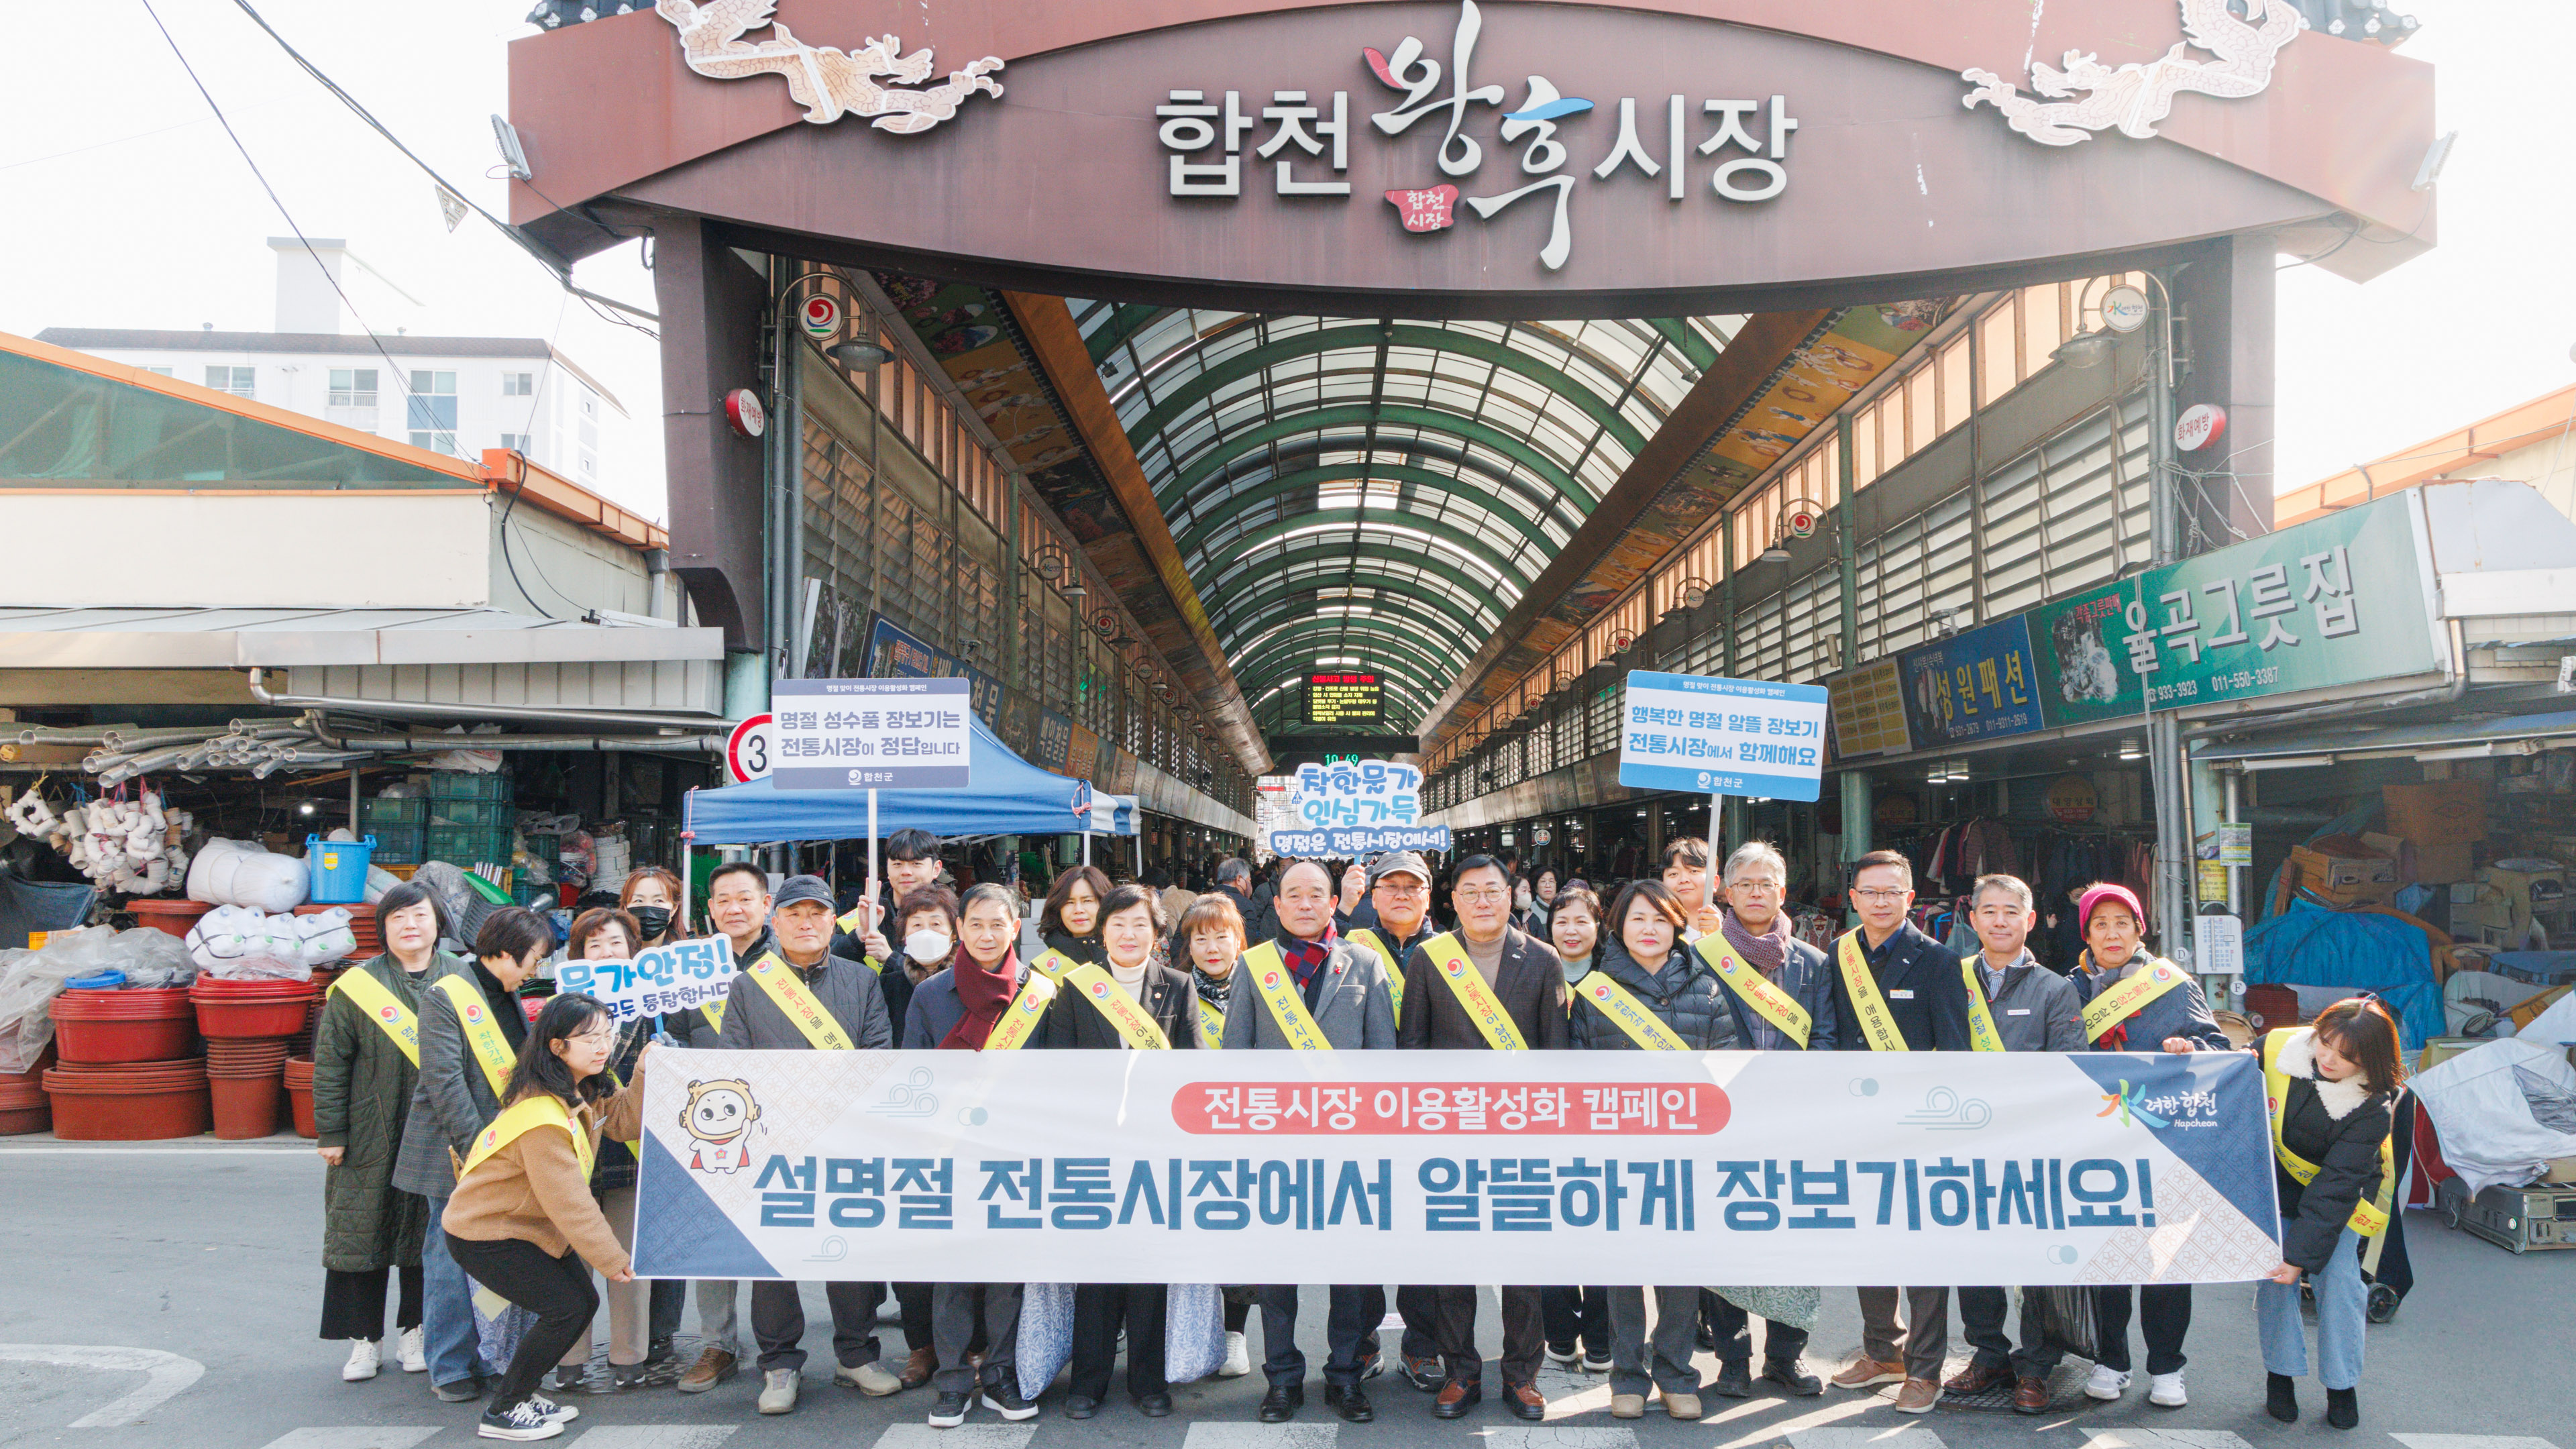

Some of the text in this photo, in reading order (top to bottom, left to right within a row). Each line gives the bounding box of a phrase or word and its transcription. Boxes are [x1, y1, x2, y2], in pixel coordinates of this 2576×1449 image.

[1407, 190, 1444, 209] 합천
[1407, 212, 1444, 229] 시장
[741, 397, 763, 429] 화재예방
[2178, 412, 2210, 441] 화재예방
[2074, 592, 2123, 624] 각종그릇판매
[2122, 545, 2360, 674] 율곡그릇집
[1683, 681, 1785, 697] 명절 맞이 전통시장 이용활성화 캠페인
[1936, 649, 2028, 720] 성원패션
[2158, 666, 2279, 701] 933-3923 011-550-3387
[781, 710, 961, 729] 명절 성수품 장보기는
[1631, 706, 1684, 727] 행복한
[1689, 711, 1723, 730] 명절
[1728, 714, 1762, 733] 알뜰
[1768, 718, 1819, 738] 장보기
[781, 737, 960, 757] 전통시장이 정답입니다
[1629, 733, 1817, 767] 전통시장에서 함께해요
[863, 772, 894, 782] 합천군
[1713, 776, 1743, 788] 합천군
[1275, 829, 1446, 853] 명절은 전통시장에서!
[561, 939, 731, 997] 물가안정!
[1844, 943, 1868, 999] 전통시장을
[643, 981, 731, 1013] 동참합시다
[775, 977, 824, 1030] 전통시장을
[1464, 981, 1499, 1021] 전통시장이
[1613, 1000, 1646, 1026] 착한가격
[1744, 978, 1799, 1025] 전통시장을
[1110, 999, 1148, 1037] 전통시장이
[1276, 996, 1316, 1050] 전통시장
[1971, 1014, 1987, 1035] 명절
[2085, 1008, 2111, 1030] 살아야
[479, 1030, 505, 1066] 착한가격
[1204, 1087, 1698, 1130] 전통시장 이용활성화 캠페인
[2174, 1118, 2218, 1131] Hapcheon
[753, 1154, 2157, 1232] 설명절 전통시장에서 알뜰하게 장보기하세요!
